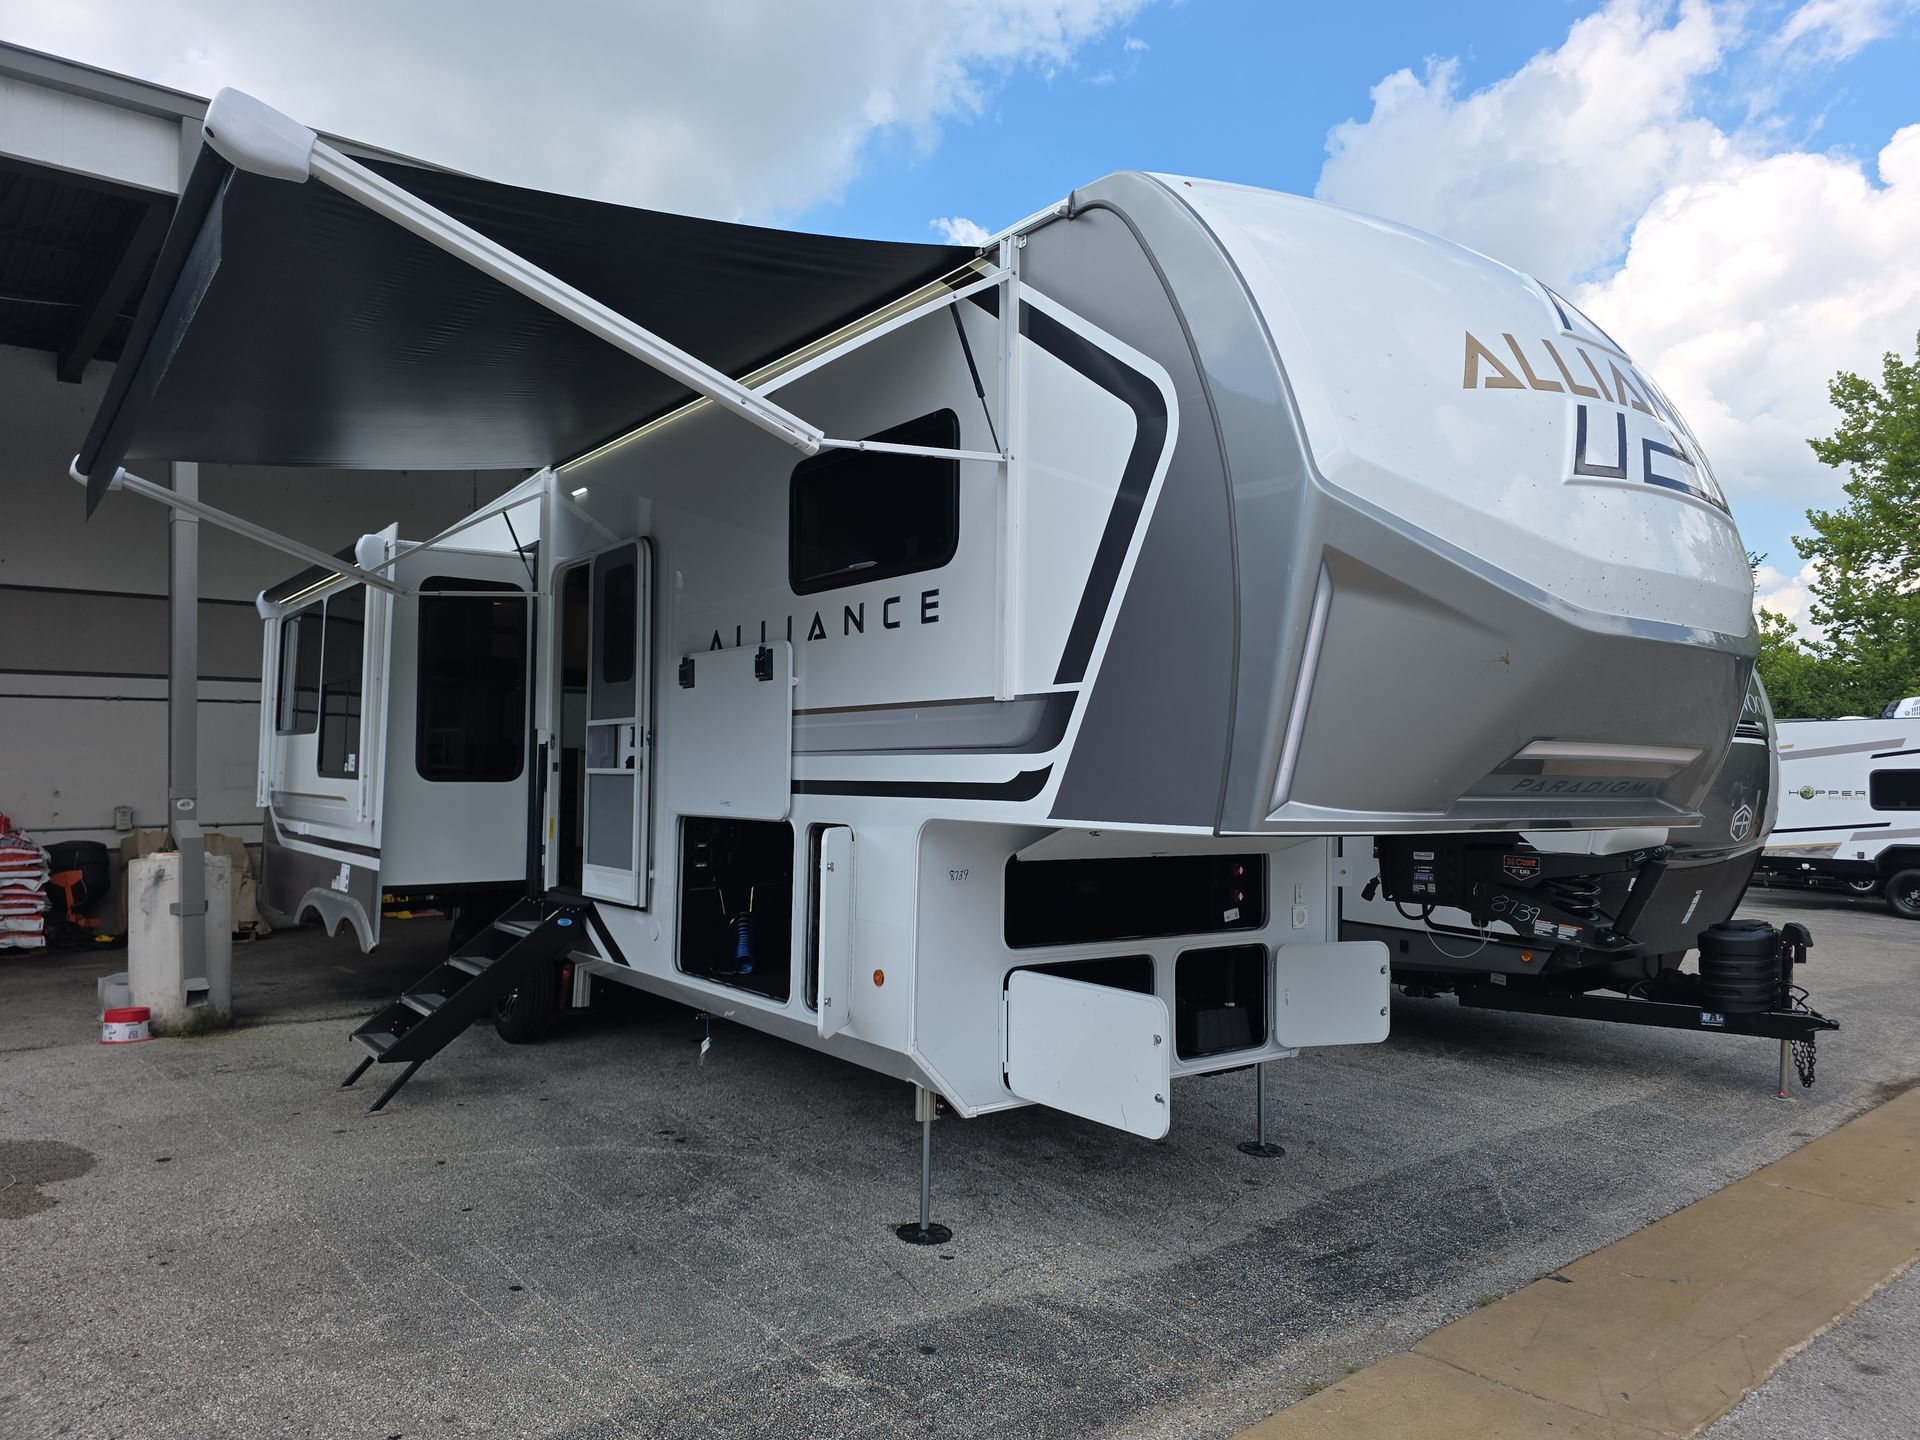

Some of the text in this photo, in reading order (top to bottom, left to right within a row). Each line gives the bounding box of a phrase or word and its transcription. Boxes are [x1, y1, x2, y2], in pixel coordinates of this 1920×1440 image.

[1512, 778, 1648, 793] PARADIGM
[949, 868, 969, 881] 8739
[1490, 893, 1541, 925] 8739
